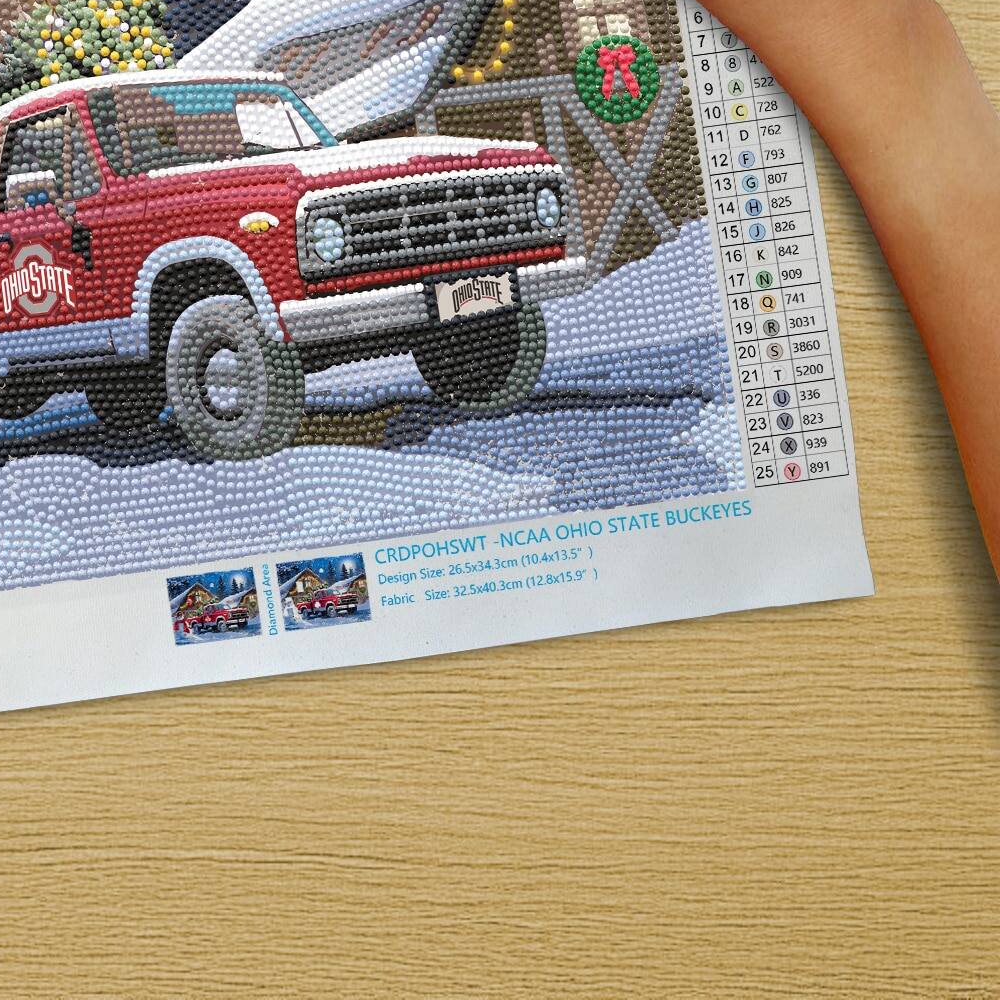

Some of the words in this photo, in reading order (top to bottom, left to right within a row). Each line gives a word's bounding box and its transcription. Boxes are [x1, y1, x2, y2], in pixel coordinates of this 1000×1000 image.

[694, 12, 702, 24] 6
[697, 35, 705, 47] 7
[725, 34, 732, 44] 7
[702, 60, 710, 71] 8
[729, 58, 736, 68] 8
[705, 83, 713, 95] 9
[733, 82, 741, 93] A
[754, 77, 774, 88] 522
[704, 106, 721, 119] 10
[736, 106, 744, 117] C
[757, 101, 778, 112] 728
[707, 130, 723, 143] 11
[740, 130, 749, 141] D
[760, 125, 781, 136] 762
[712, 154, 728, 167] 12
[743, 154, 750, 164] F
[764, 149, 784, 160] 793
[714, 178, 732, 191] 13
[746, 178, 755, 189] G
[768, 173, 787, 184] 807
[718, 202, 734, 215] 14
[750, 202, 759, 213] H
[771, 196, 792, 208] 825
[722, 226, 739, 239] 15
[755, 226, 760, 238] J
[775, 220, 795, 232] 826
[725, 250, 742, 263] 16
[757, 250, 765, 260] K
[778, 245, 799, 256] 842
[728, 274, 744, 287] 17
[760, 274, 769, 285] N
[782, 269, 802, 280] 909
[732, 297, 749, 311] 18
[762, 297, 773, 309] Q
[785, 293, 805, 304] 741
[736, 322, 753, 335] 19
[768, 322, 776, 333] R
[789, 316, 815, 328] 3031
[738, 346, 756, 359] 20
[771, 346, 778, 357] S
[793, 340, 820, 352] 3860
[742, 369, 758, 383] 21
[774, 369, 782, 380] T
[796, 364, 824, 376] 5200
[745, 394, 763, 407] 22
[778, 392, 786, 404] U
[800, 389, 820, 400] 336
[749, 417, 767, 431] 23
[781, 416, 790, 427] V
[803, 413, 824, 425] 823
[752, 442, 770, 455] 24
[785, 440, 793, 452] X
[806, 437, 827, 449] 939
[756, 465, 774, 479] 25
[788, 466, 796, 477] Y
[810, 461, 830, 473] 891
[375, 536, 487, 564] CRDPOHSWT
[556, 520, 603, 540] OHIO
[608, 512, 660, 534] STATE
[666, 500, 752, 526] BUCKEYES
[262, 564, 271, 587] Area
[379, 570, 417, 587] Design
[420, 566, 445, 580] Size:
[448, 558, 518, 576] 26.5x34.3cm
[381, 593, 414, 607] Fabric
[424, 588, 450, 601] Size:
[453, 579, 523, 598] 32.5x40.3cm
[264, 589, 278, 636] Diamond
